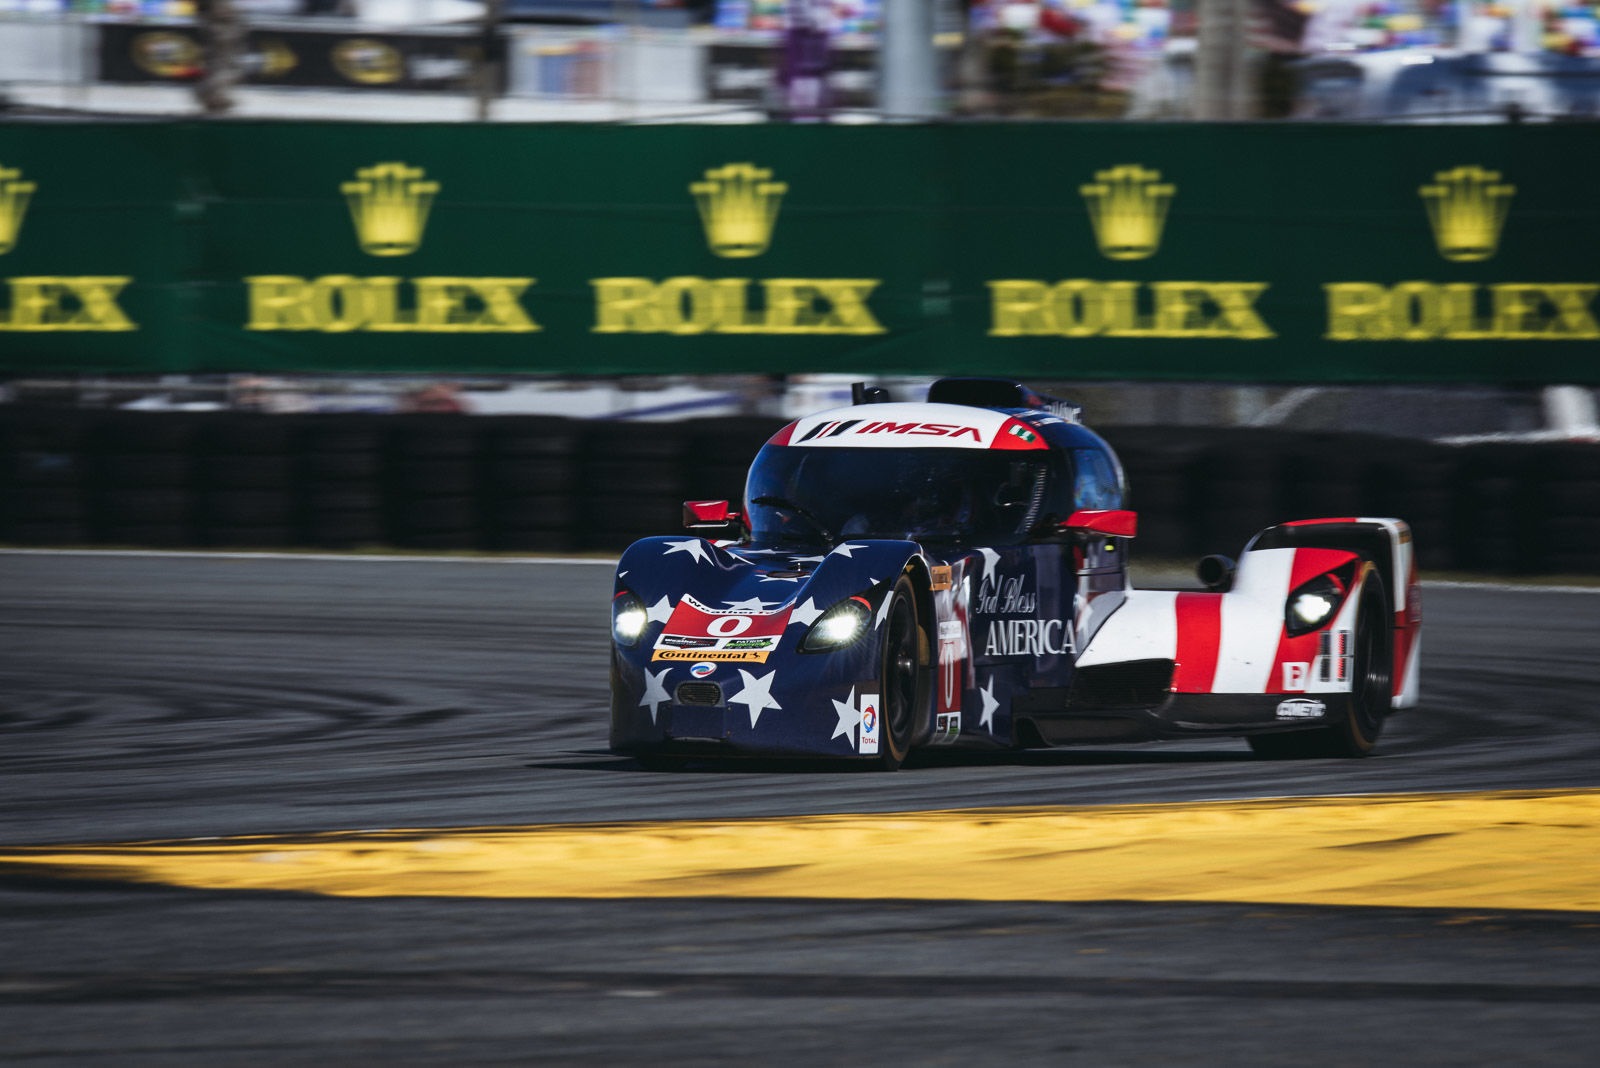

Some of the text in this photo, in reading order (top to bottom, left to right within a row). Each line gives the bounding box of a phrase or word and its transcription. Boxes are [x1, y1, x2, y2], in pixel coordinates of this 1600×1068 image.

[0, 276, 135, 332] EX
[246, 275, 540, 333] ROLEX
[592, 276, 884, 335] ROLEX
[989, 279, 1275, 340] ROLEX
[856, 421, 982, 443] IMSA
[976, 574, 1003, 614] God
[1001, 574, 1037, 613] Bless
[706, 615, 753, 637] 0
[984, 618, 1077, 657] AMERICA
[658, 650, 747, 660] Continental
[862, 736, 877, 745] TOTAL
